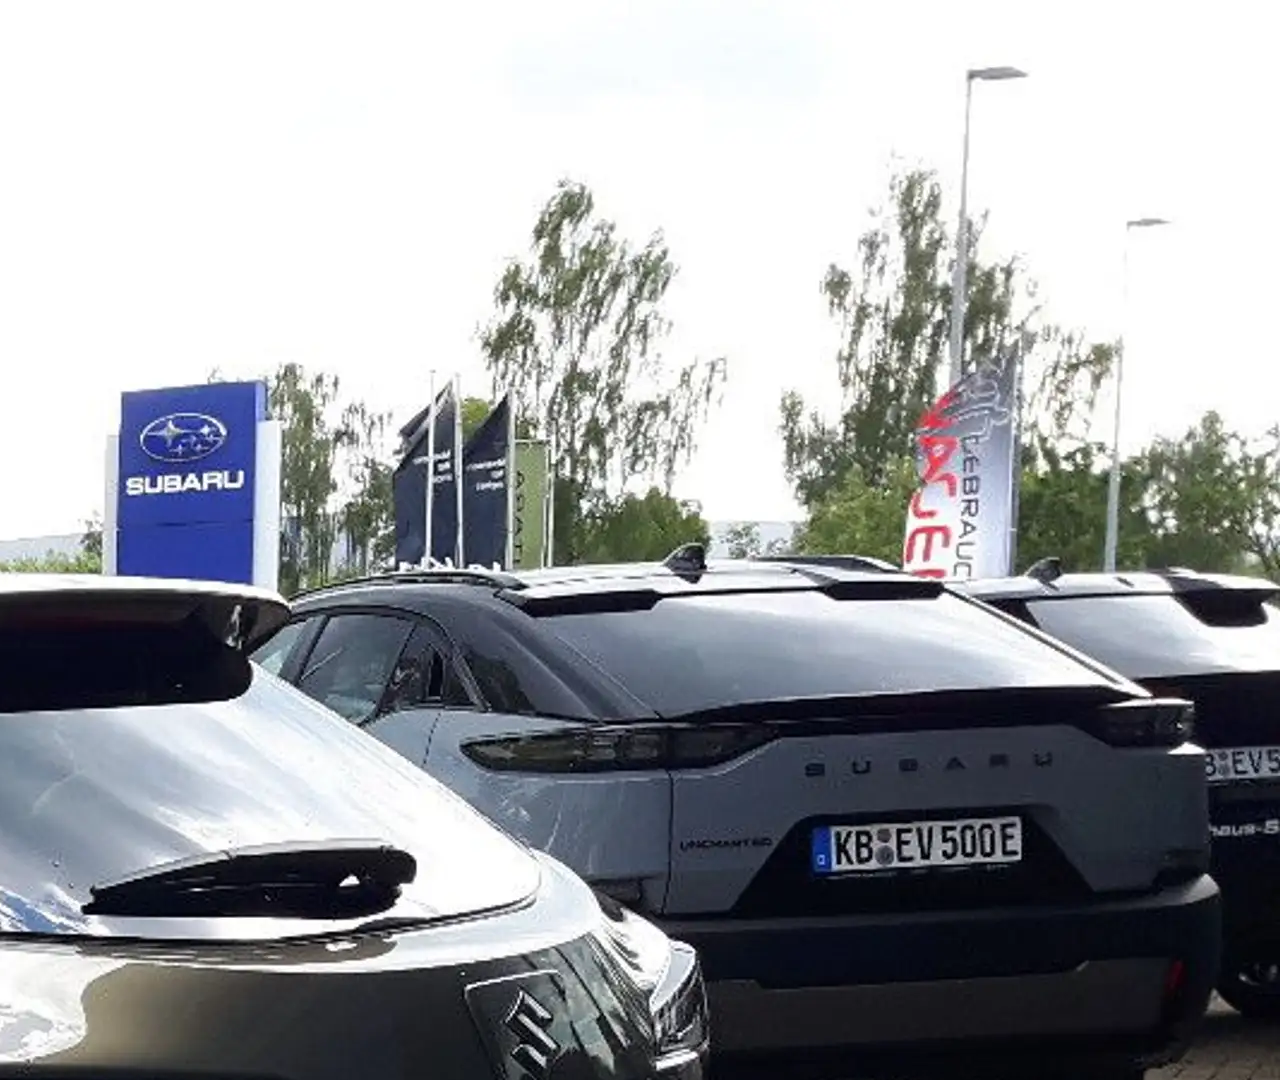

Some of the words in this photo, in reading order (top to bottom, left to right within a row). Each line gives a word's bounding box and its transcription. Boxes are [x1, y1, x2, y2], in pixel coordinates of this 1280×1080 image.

[126, 469, 245, 496] SUBARU
[953, 434, 981, 579] GEBRAUC
[804, 752, 1053, 777] SUBARU
[1232, 751, 1262, 775] EV
[835, 830, 874, 866] KB
[894, 827, 933, 863] EV
